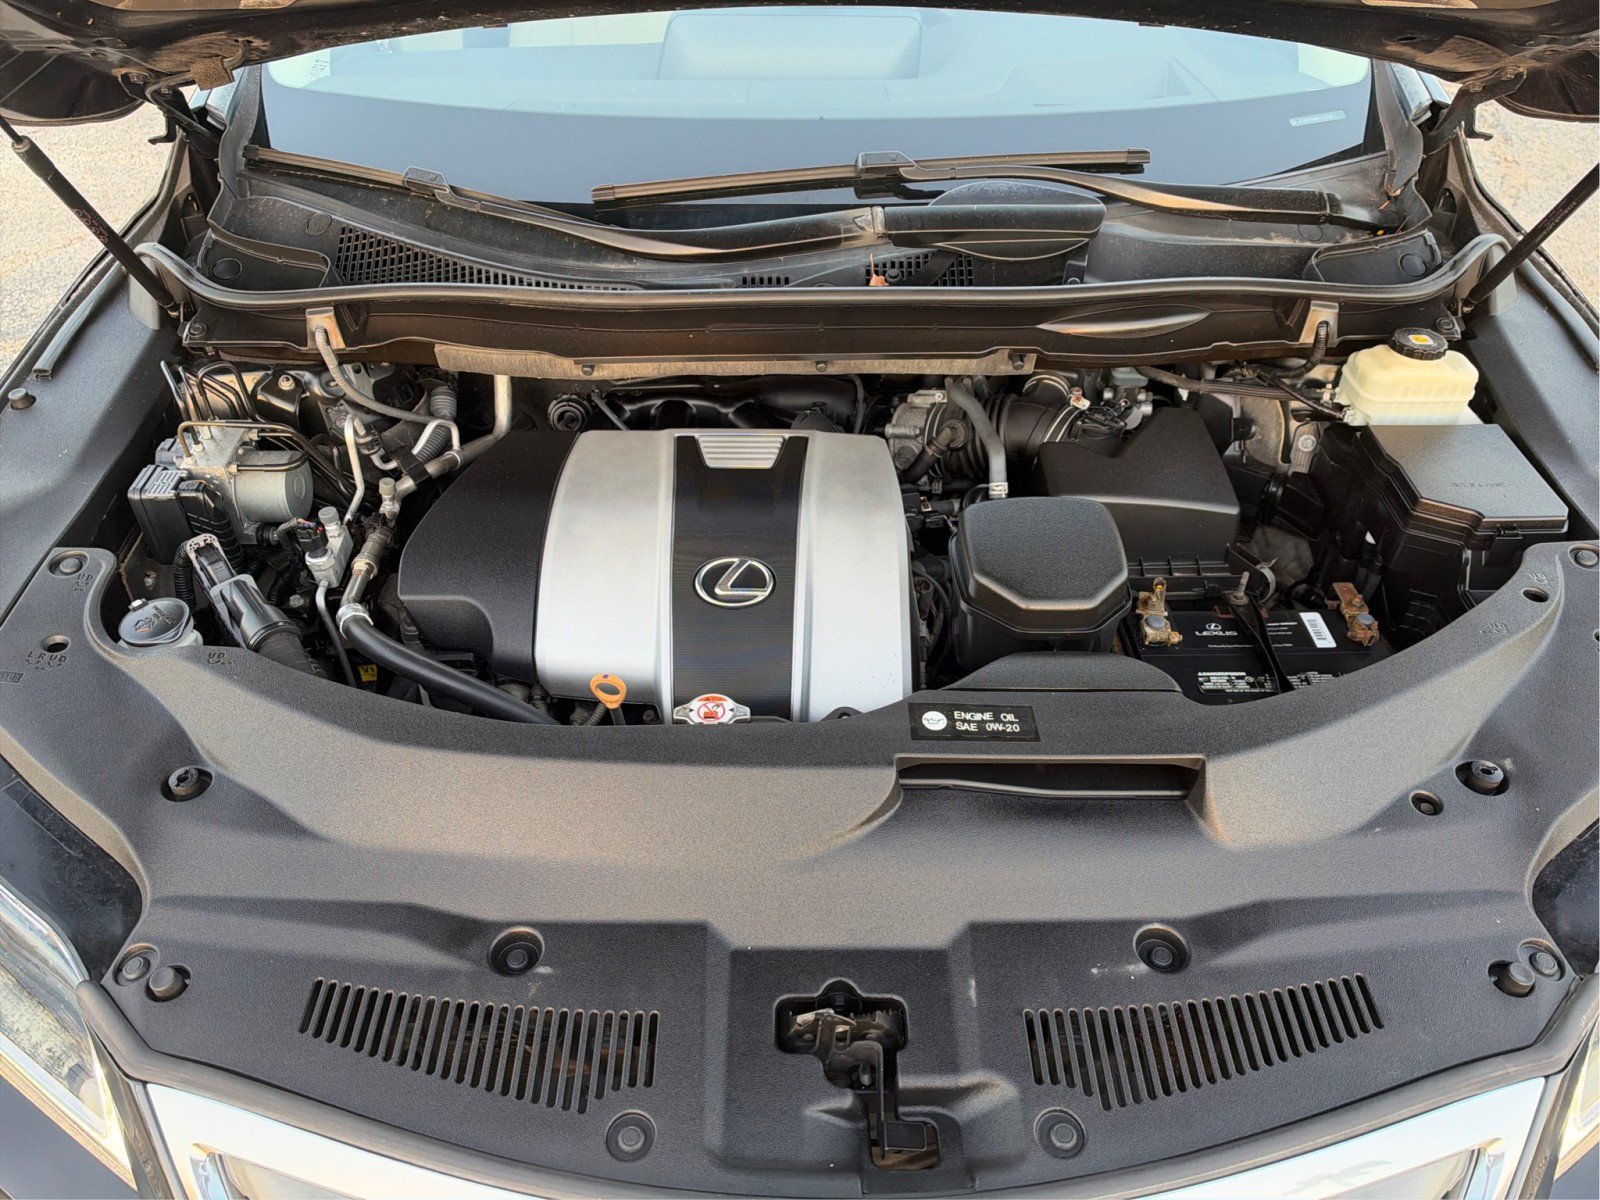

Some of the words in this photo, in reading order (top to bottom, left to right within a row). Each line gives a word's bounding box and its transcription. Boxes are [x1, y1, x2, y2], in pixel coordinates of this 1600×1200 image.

[954, 711, 994, 720] ENGINE
[1000, 713, 1019, 722] OIL
[955, 721, 978, 731] SAE
[985, 722, 1020, 732] 0W-20
